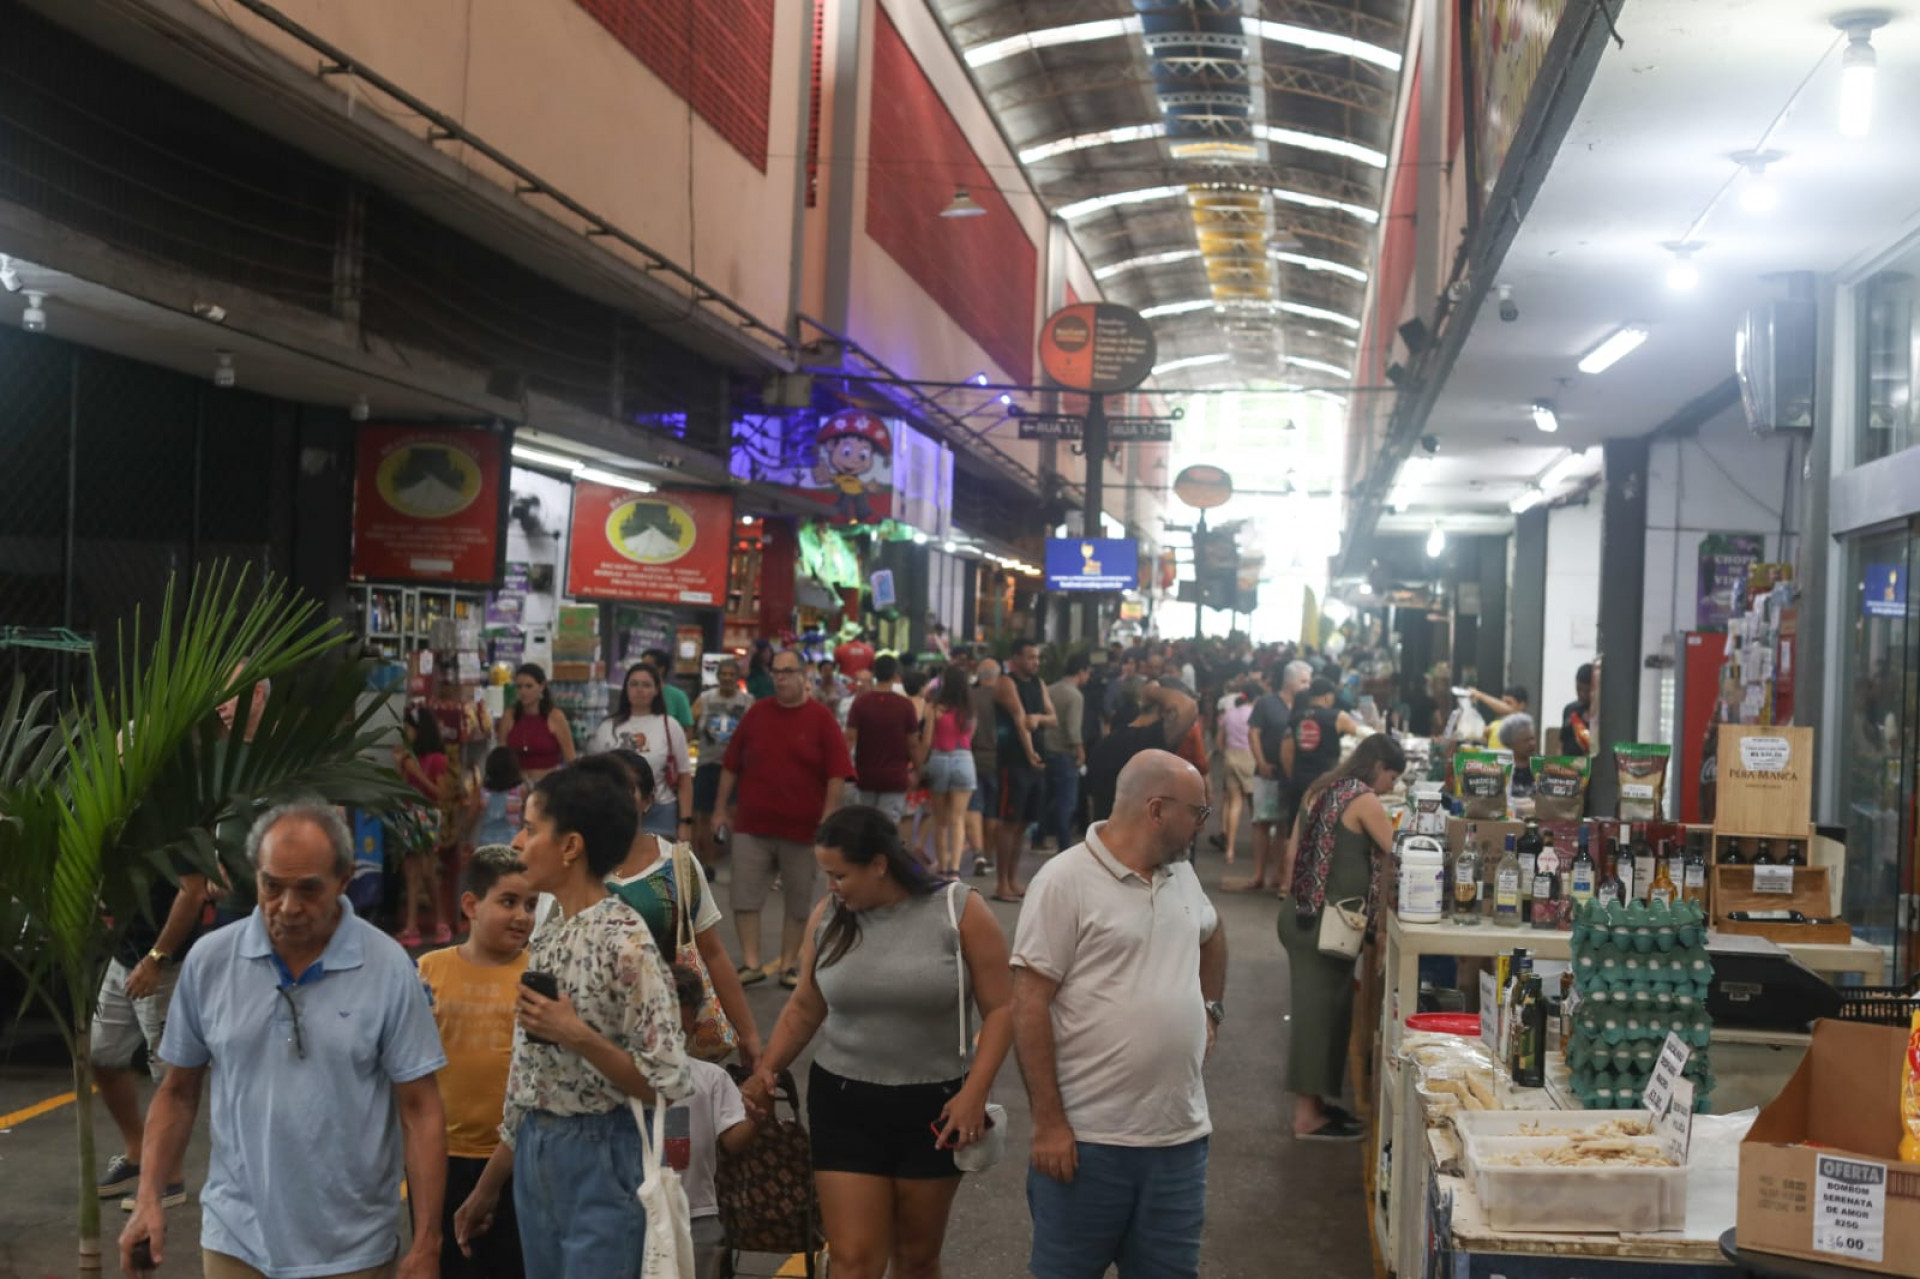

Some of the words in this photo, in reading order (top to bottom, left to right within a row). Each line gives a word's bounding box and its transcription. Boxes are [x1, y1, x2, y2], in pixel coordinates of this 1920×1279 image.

[1823, 1160, 1880, 1183] OFERTA
[1827, 1182, 1870, 1195] BOMBOM
[1823, 1193, 1873, 1208] SERENATA
[1826, 1205, 1838, 1214] DE
[1841, 1207, 1869, 1220] AMOR
